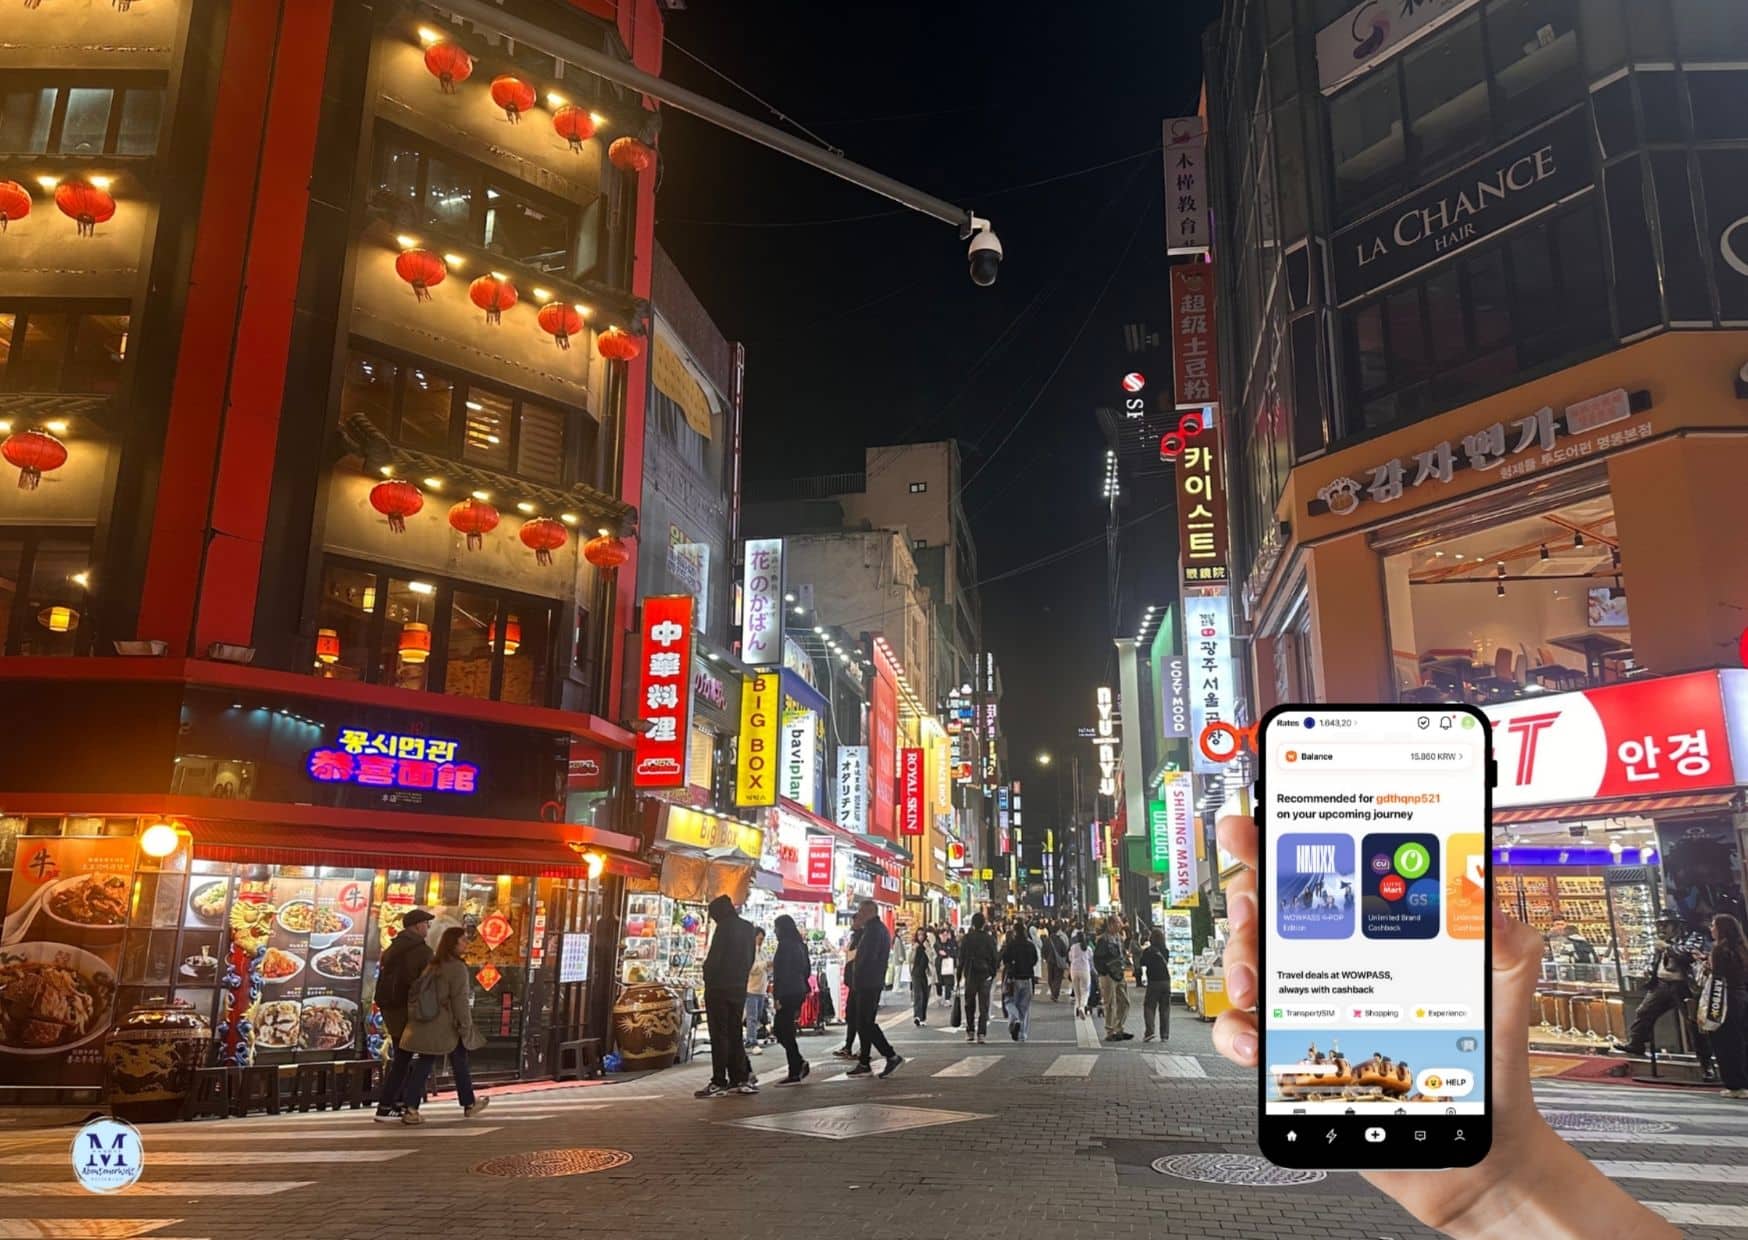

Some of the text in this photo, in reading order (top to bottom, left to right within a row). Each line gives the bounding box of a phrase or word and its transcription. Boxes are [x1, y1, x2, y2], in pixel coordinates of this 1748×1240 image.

[1357, 144, 1557, 267] LA CHANCE
[1435, 223, 1477, 251] HAIR
[1184, 447, 1216, 558] 카이스트
[748, 550, 770, 650] 花のかばん
[645, 620, 683, 741] 中華料理
[1171, 660, 1185, 732] COZY MOOD
[749, 678, 766, 789] BIG BOX
[1276, 719, 1299, 727] Rates
[789, 730, 804, 800] baviplan
[1301, 752, 1333, 761] Balance
[1437, 752, 1456, 761] KRW
[1491, 711, 1562, 786] T
[1617, 730, 1711, 781] 안경
[907, 752, 917, 830] ROYAL SKIN
[1277, 794, 1356, 803] Recommended
[1358, 794, 1374, 803] for
[1173, 791, 1187, 845] SHINING
[1276, 809, 1413, 821] on your upcoming journey
[29, 848, 56, 878] 牛
[1177, 849, 1189, 886] MASK
[349, 886, 365, 906] 牛
[1277, 971, 1393, 981] Travel deals at WOWPASS,
[1278, 986, 1374, 995] always with cashback
[1364, 1009, 1399, 1019] Shopping
